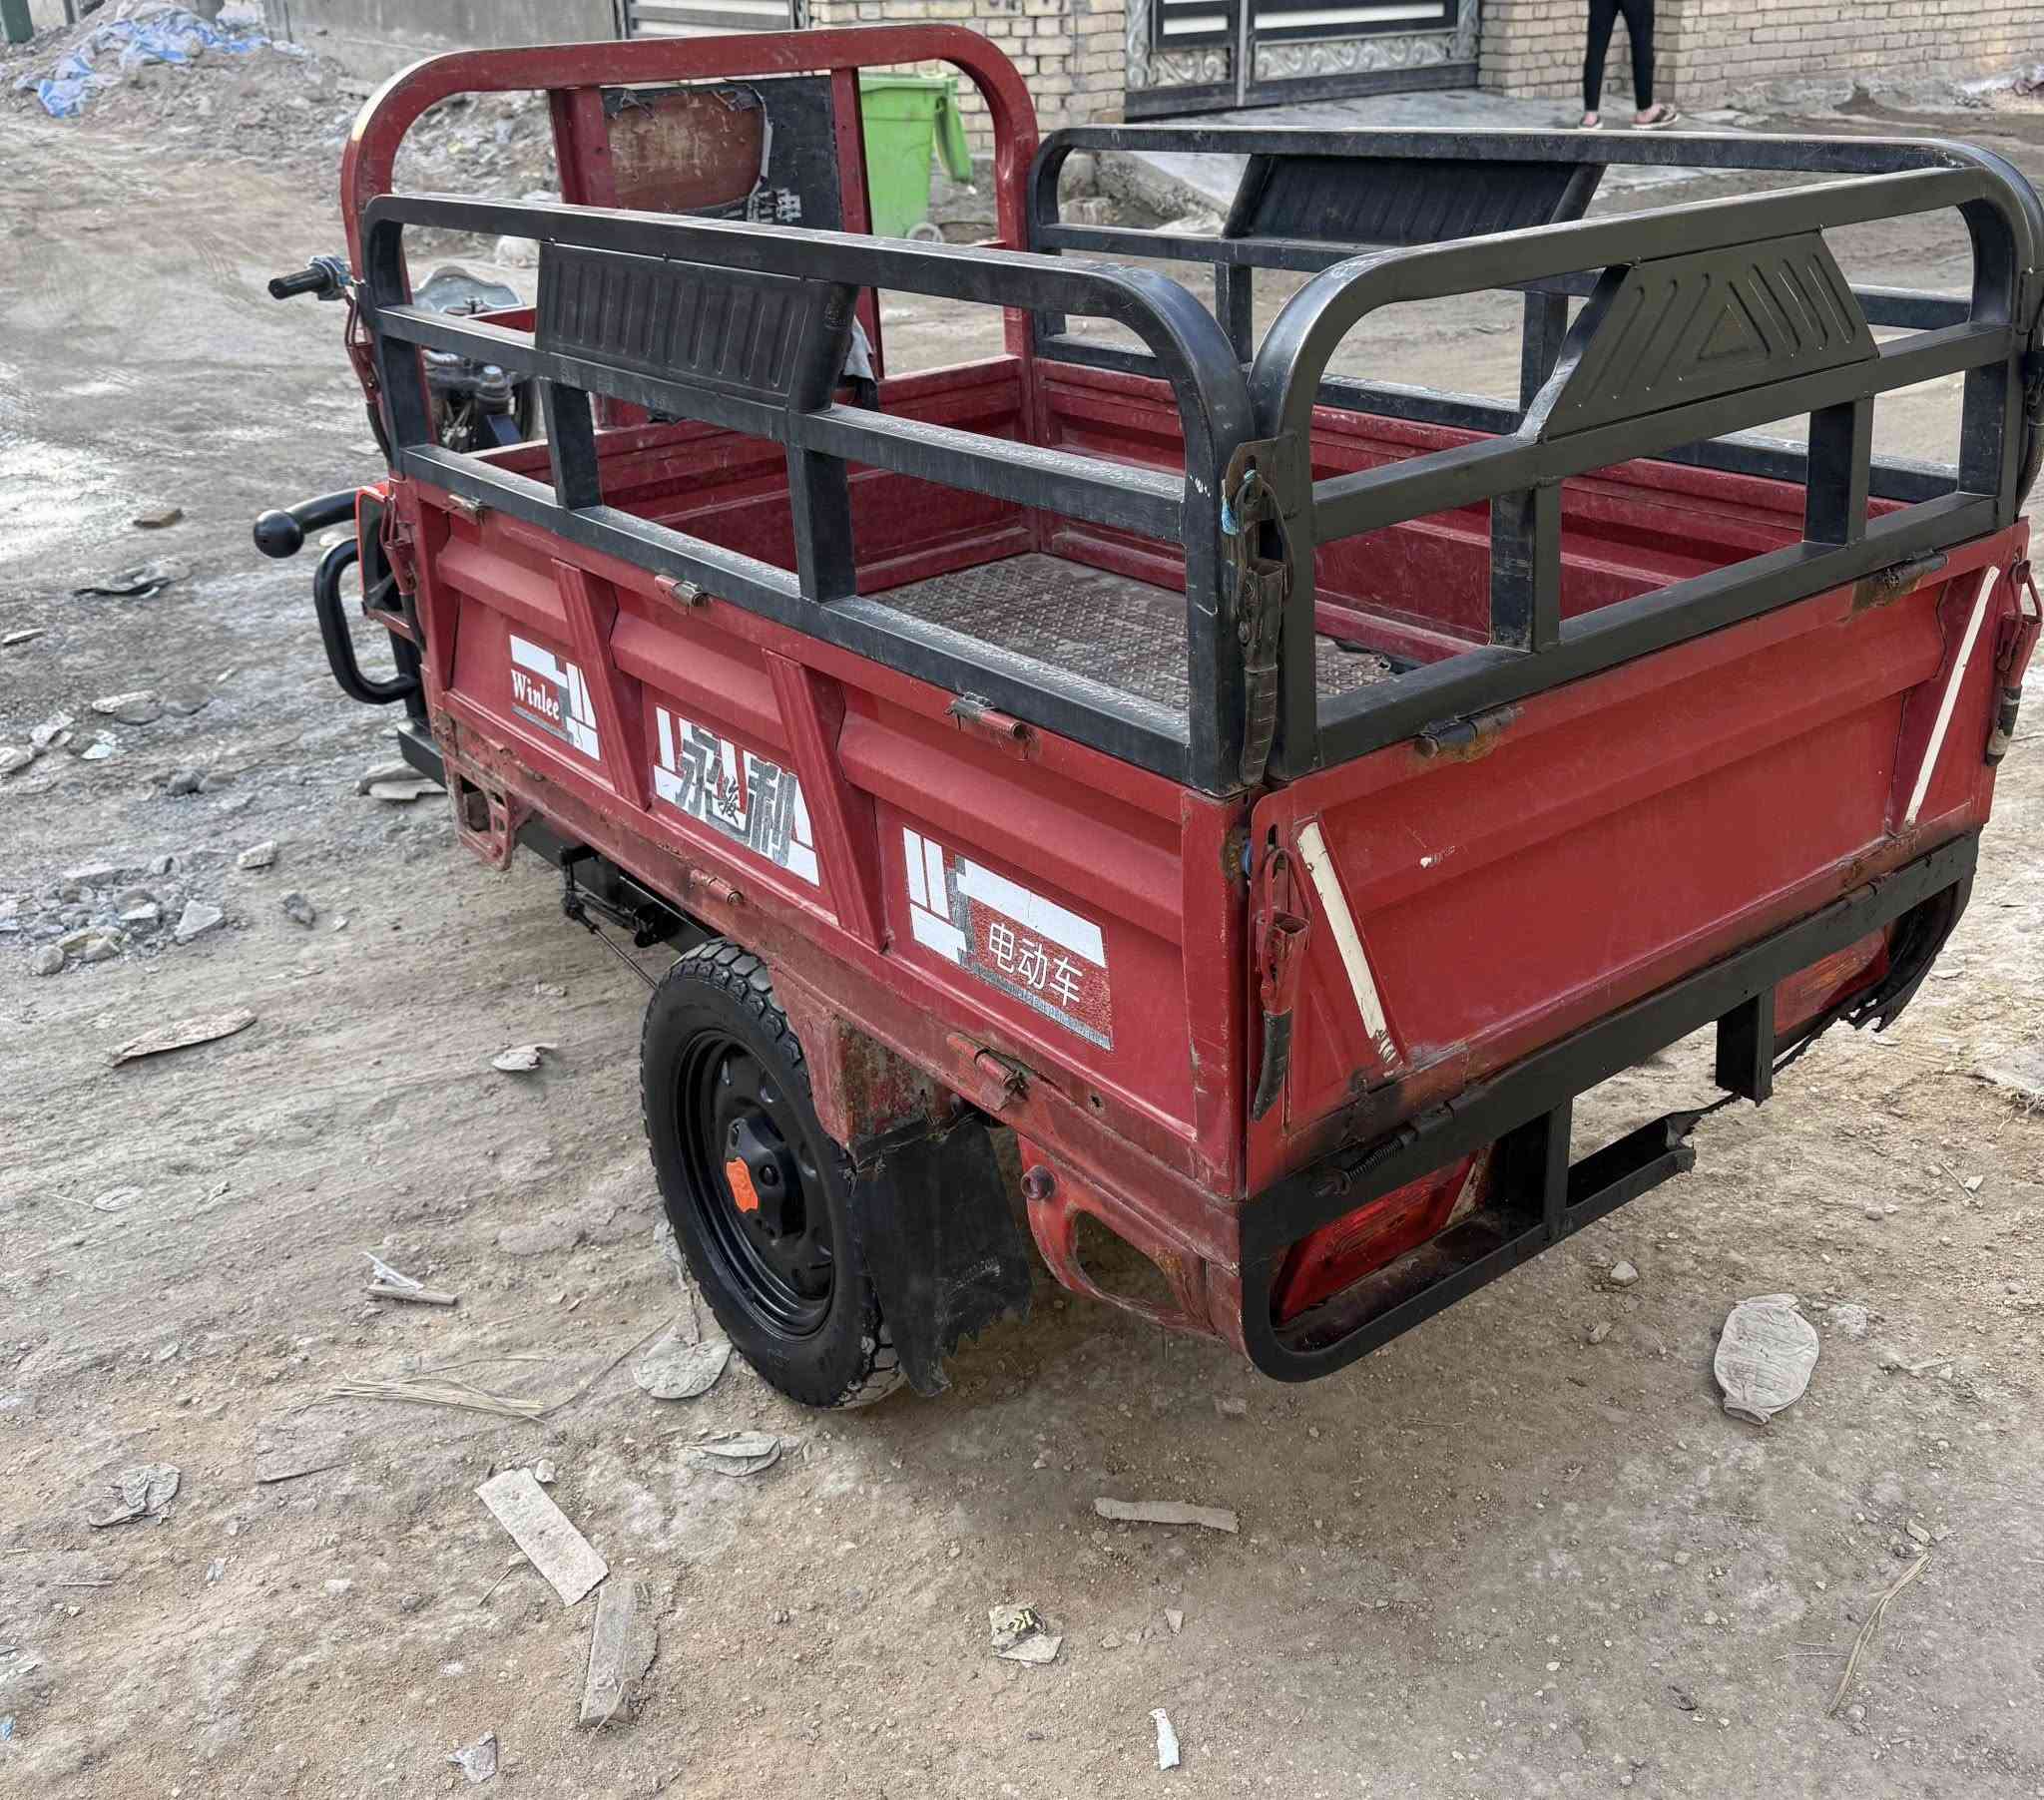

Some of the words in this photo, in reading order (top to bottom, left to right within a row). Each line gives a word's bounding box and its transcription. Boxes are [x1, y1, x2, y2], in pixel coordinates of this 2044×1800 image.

[511, 669, 560, 720] Winlee
[989, 922, 1083, 1007] 电动车
